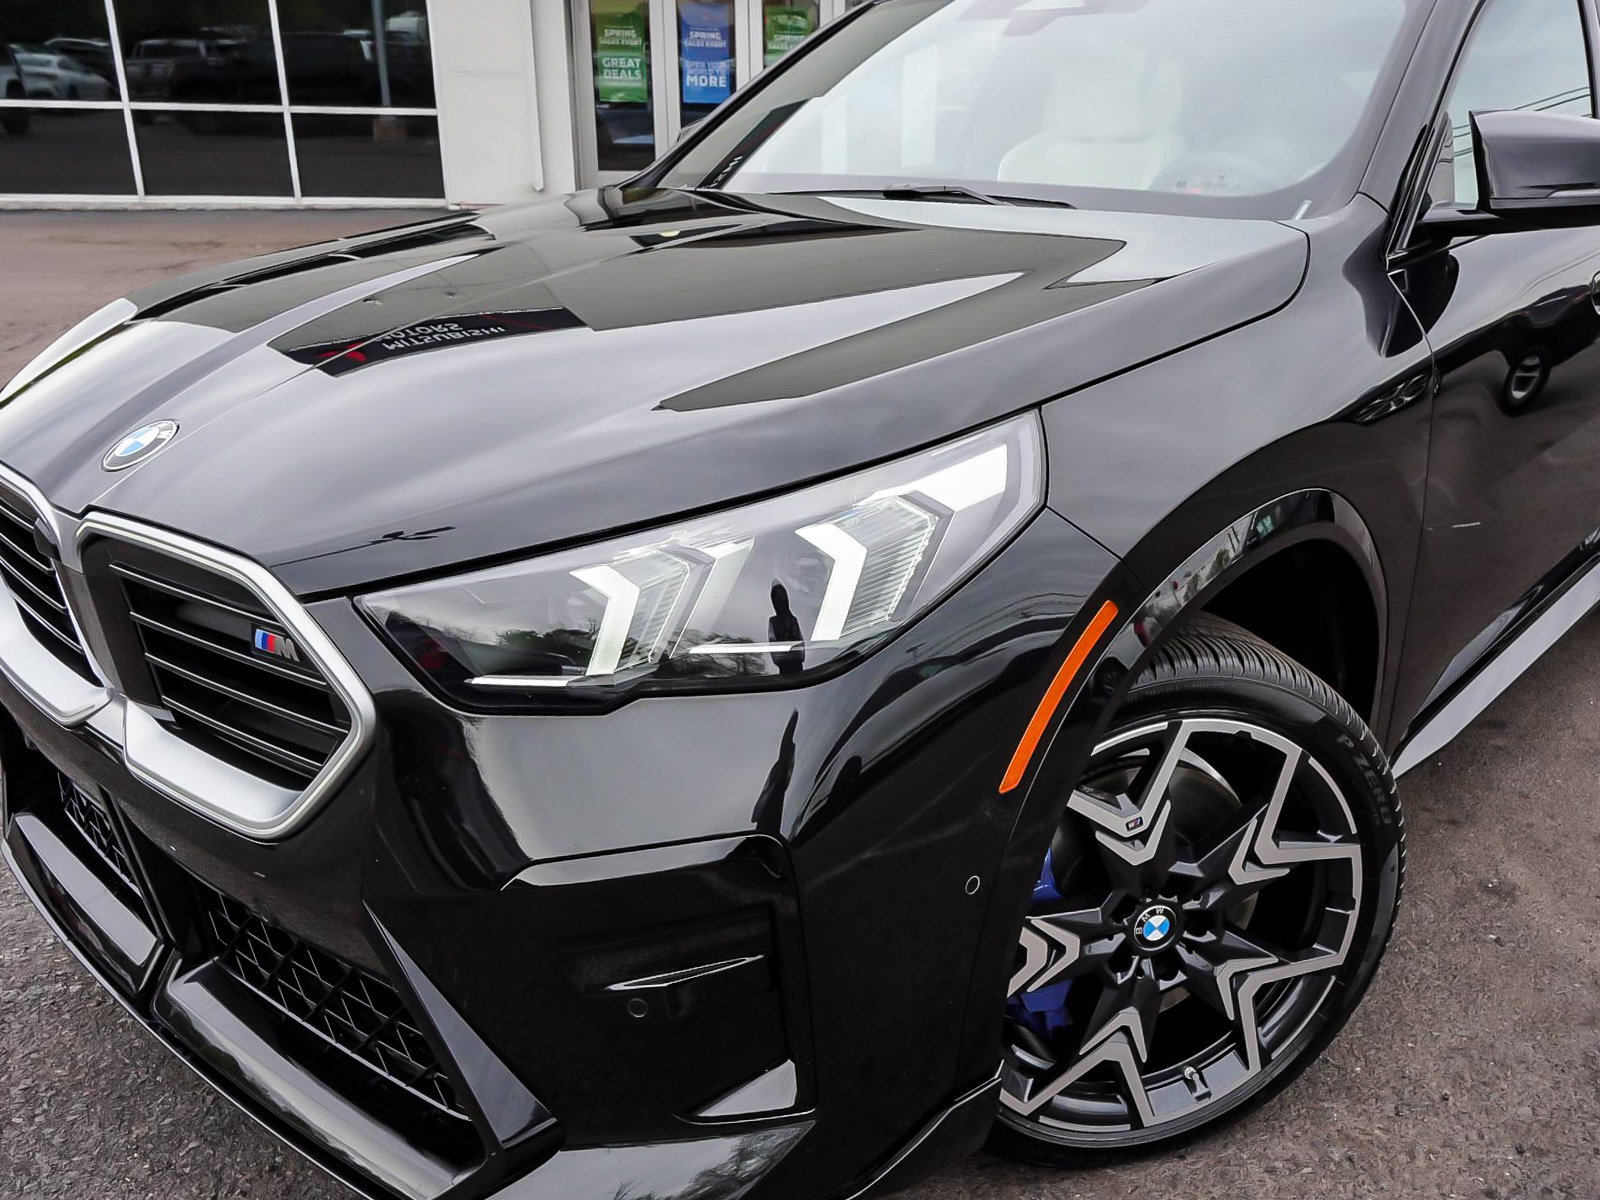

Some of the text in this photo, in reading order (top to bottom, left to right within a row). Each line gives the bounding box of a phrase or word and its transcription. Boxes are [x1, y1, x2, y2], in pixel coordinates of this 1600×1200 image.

[604, 29, 637, 38] SPRING
[689, 31, 721, 40] SPRING
[602, 57, 641, 68] GREAT
[603, 69, 641, 80] DEALS
[686, 75, 727, 88] MORE
[1135, 906, 1165, 935] BMW
